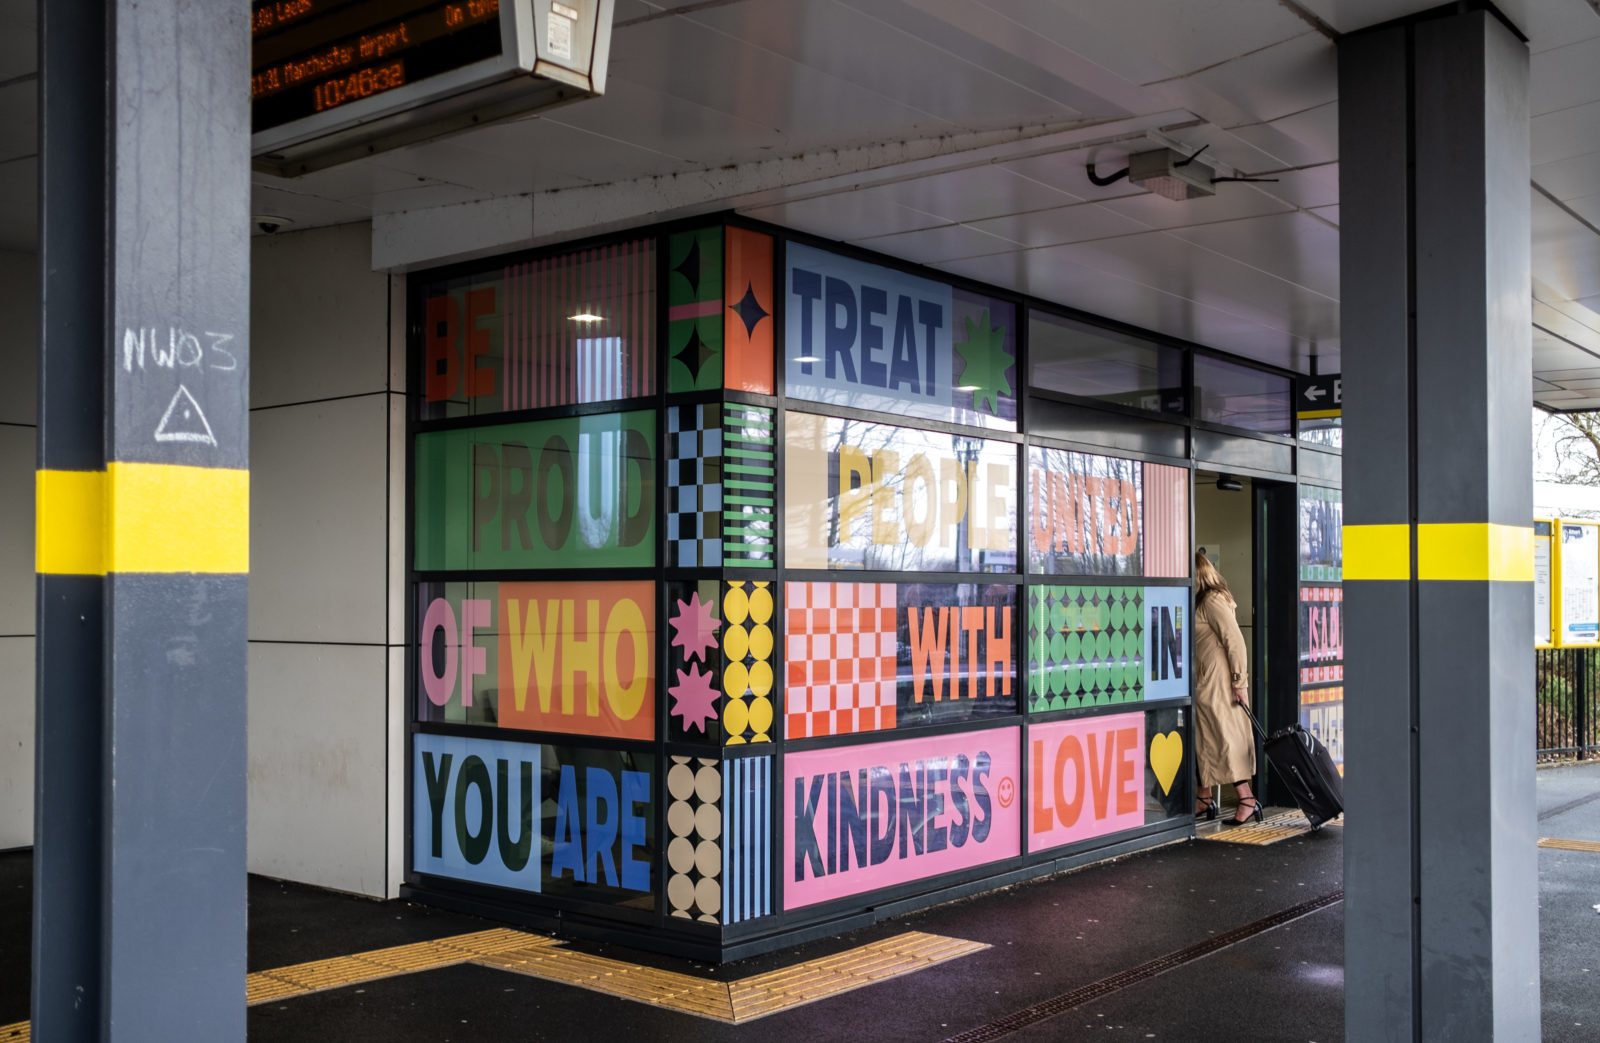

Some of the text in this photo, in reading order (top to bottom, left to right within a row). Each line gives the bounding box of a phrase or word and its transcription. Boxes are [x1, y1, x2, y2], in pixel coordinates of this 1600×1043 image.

[284, 46, 353, 83] Manchester
[360, 22, 408, 57] Airport
[445, 5, 463, 26] On
[426, 287, 496, 402] BE
[792, 267, 943, 397] TREAT
[473, 429, 651, 552] PROUD
[839, 445, 1010, 550] PEOPLE
[1033, 470, 1139, 556] UNITED
[421, 598, 649, 721] OF WHO
[908, 606, 1011, 703] WITH
[1151, 606, 1182, 681] IN
[422, 751, 650, 892] YOU ARE
[795, 751, 992, 882] KINDNESS
[1034, 727, 1138, 834] LOVE
